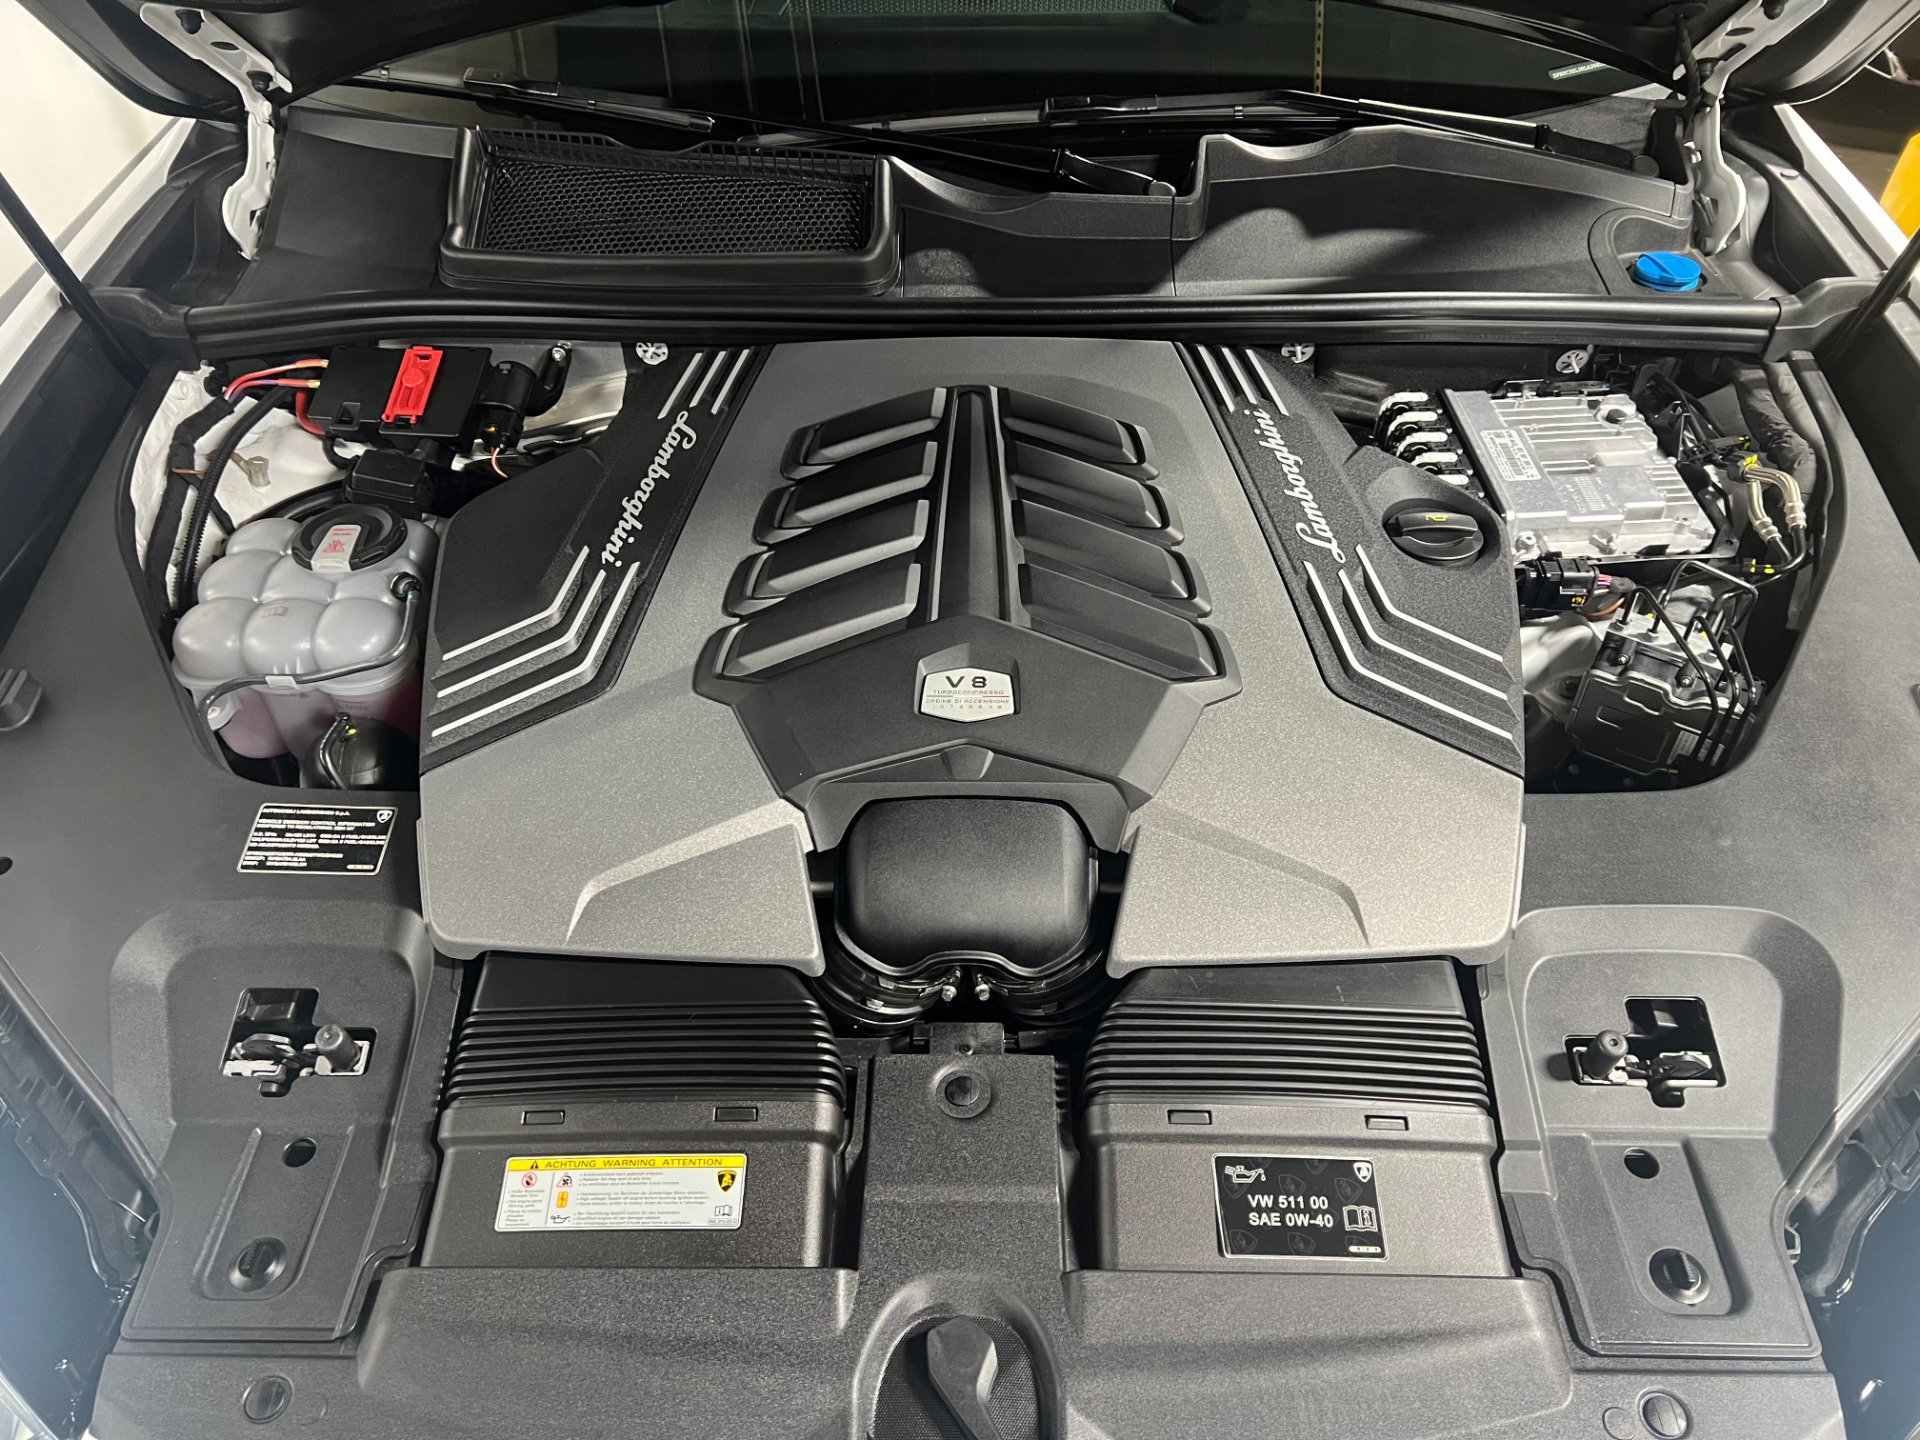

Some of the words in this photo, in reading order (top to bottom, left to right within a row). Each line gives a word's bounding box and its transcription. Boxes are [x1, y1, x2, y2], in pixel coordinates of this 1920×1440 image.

[602, 410, 697, 567] Lamborghini
[1243, 408, 1346, 564] Lamborghini
[545, 1160, 596, 1168] ACHTUNG
[603, 1159, 656, 1167] WARNING
[662, 1158, 722, 1166] ATTENTION
[1247, 1194, 1273, 1208] VW
[1279, 1195, 1304, 1209] 511
[1310, 1195, 1328, 1210] 00
[1248, 1211, 1281, 1226] SAE
[1285, 1212, 1334, 1228] 0W-40
